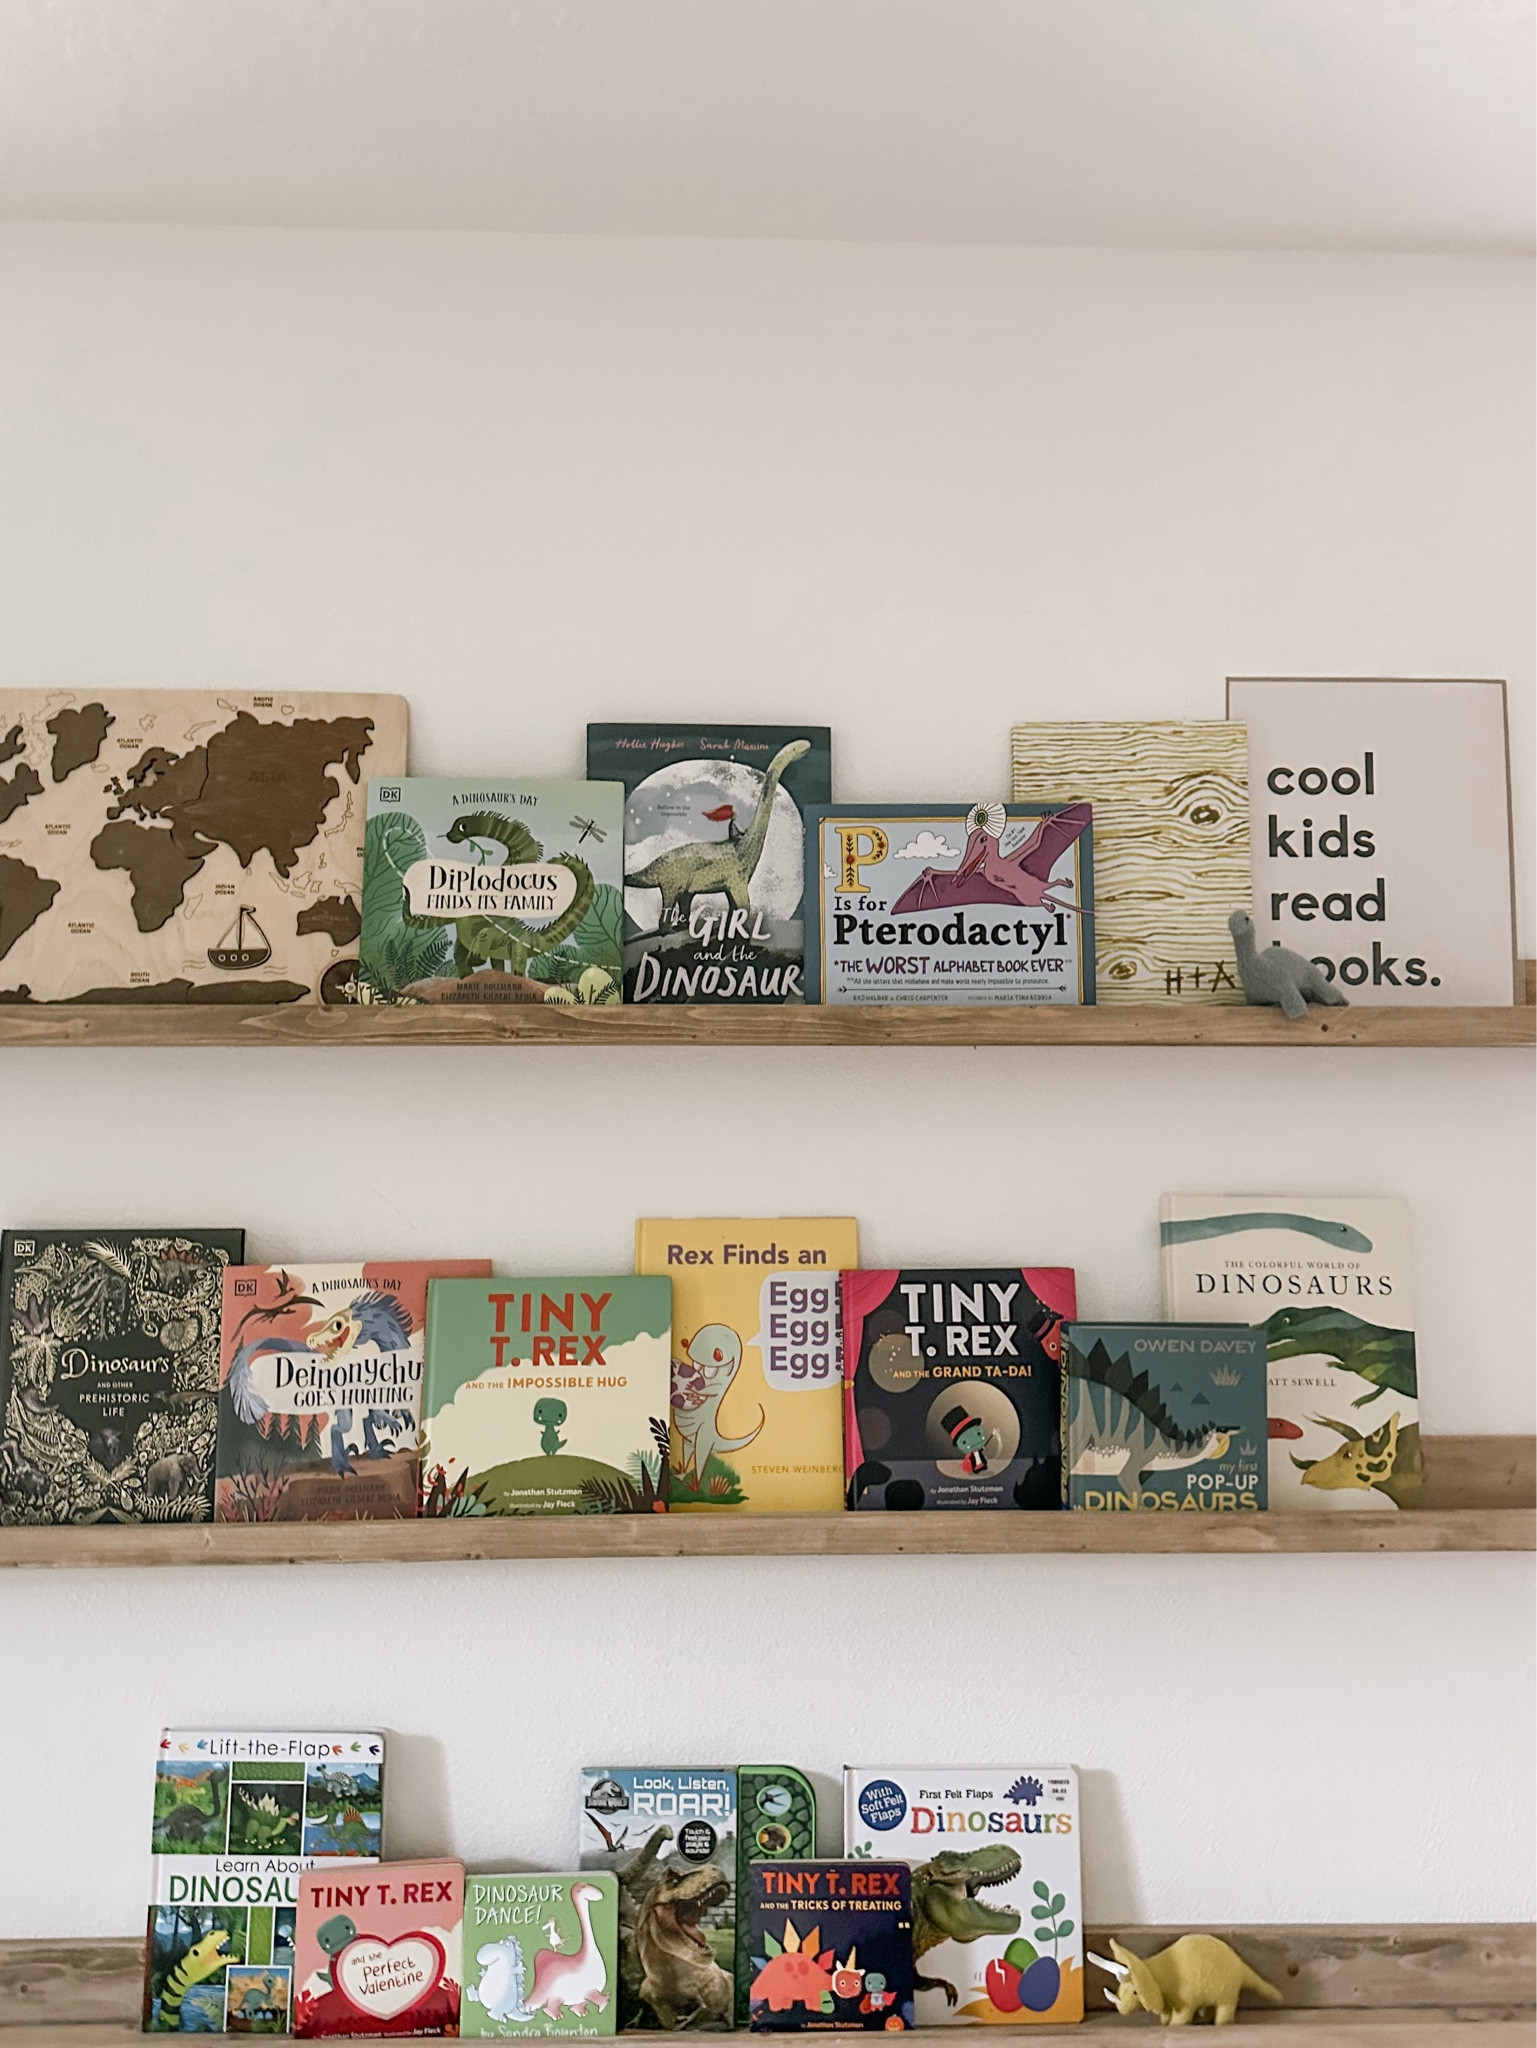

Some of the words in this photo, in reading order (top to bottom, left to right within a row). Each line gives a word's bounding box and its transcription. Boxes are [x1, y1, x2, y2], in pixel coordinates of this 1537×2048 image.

[700, 737, 730, 751] Sarah
[1266, 751, 1375, 796] cool
[382, 789, 399, 800] DK
[452, 794, 459, 806] A
[461, 792, 516, 804] DINOSAUR'S
[519, 794, 539, 806] DAY
[1268, 814, 1377, 858] kids
[834, 825, 890, 894] P
[429, 865, 558, 893] Diplodocus
[427, 894, 472, 909] FINDS
[478, 894, 498, 910] ITS
[504, 895, 557, 911] FAMILY
[834, 896, 852, 912] Is
[858, 895, 888, 912] for
[1271, 877, 1386, 921] read
[661, 901, 687, 926] The
[693, 944, 726, 961] and
[731, 944, 757, 963] the
[865, 956, 931, 976] WORST
[933, 959, 995, 974] ALPHABET
[996, 959, 1029, 974] BOOK
[1272, 940, 1442, 987] ooks.
[633, 951, 805, 1003] DINOSAUR
[16, 1242, 33, 1254] DK
[667, 1244, 715, 1265] Rex
[723, 1242, 790, 1265] Finds
[797, 1248, 827, 1265] an
[1224, 1260, 1245, 1269] THE
[1248, 1260, 1304, 1270] COLORFUL
[1306, 1261, 1345, 1270] WORLD
[1347, 1261, 1362, 1270] OF
[236, 1281, 255, 1294] DK
[311, 1282, 320, 1294] A
[322, 1278, 380, 1292] DINOSAUR'S
[383, 1278, 402, 1291] DAY
[1195, 1273, 1393, 1296] DINOSAURS
[900, 1282, 1020, 1323] TINY
[488, 1292, 613, 1333] TINY
[904, 1325, 937, 1357] T.
[946, 1325, 1019, 1357] REX
[1133, 1338, 1195, 1353] OWEN
[1200, 1339, 1257, 1355] DAVEY
[490, 1336, 521, 1368] T.
[532, 1335, 607, 1367] REX
[60, 1347, 170, 1380] Dinosaurs
[892, 1370, 912, 1379] AND
[914, 1370, 930, 1379] THE
[932, 1366, 982, 1378] GRAND
[984, 1364, 1032, 1378] TA-DA!
[465, 1380, 485, 1390] AND
[487, 1380, 504, 1389] THE
[507, 1376, 594, 1389] IMPOSSIBLE
[597, 1376, 628, 1388] HUG
[1291, 1378, 1337, 1387] SEWELL
[79, 1393, 150, 1404] PREHISTORIC
[294, 1390, 336, 1407] GOES
[341, 1386, 414, 1406] HUNTING
[102, 1406, 126, 1417] LIFE
[751, 1465, 790, 1474] STEVEN
[1219, 1462, 1234, 1474] my
[1236, 1458, 1258, 1472] first
[1186, 1473, 1259, 1491] POP-UP
[510, 1487, 546, 1497] Jonathan
[1085, 1490, 1259, 1511] DINOSAURS
[209, 1738, 330, 1760] Lift-the-Flap
[632, 1776, 675, 1791] Look,
[678, 1776, 730, 1791] Listen,
[865, 1785, 893, 1802] With
[919, 1789, 942, 1800] First
[944, 1789, 963, 1800] Felt
[965, 1789, 994, 1801] Flaps
[633, 1790, 730, 1817] ROAR!
[861, 1798, 884, 1815] Soft
[883, 1794, 904, 1811] Felt
[869, 1806, 902, 1824] Flaps
[910, 1805, 1073, 1835] Dinosaurs
[215, 1858, 260, 1873] Learn
[264, 1858, 315, 1874] About
[762, 1872, 821, 1895] TINY
[825, 1872, 847, 1895] T.
[851, 1872, 901, 1895] REX
[310, 1885, 371, 1908] TINY
[376, 1884, 397, 1905] T.
[403, 1880, 453, 1904] REX
[473, 1884, 564, 1905] DINOSAUR
[760, 1902, 775, 1910] AND
[776, 1902, 790, 1910] THE
[790, 1899, 829, 1910] TRICKS
[831, 1900, 847, 1910] OF
[848, 1900, 902, 1911] TREATING
[474, 1904, 542, 1926] DANCE!
[351, 1954, 366, 1966] and
[368, 1951, 383, 1961] the
[498, 2024, 542, 2038] Sandra
